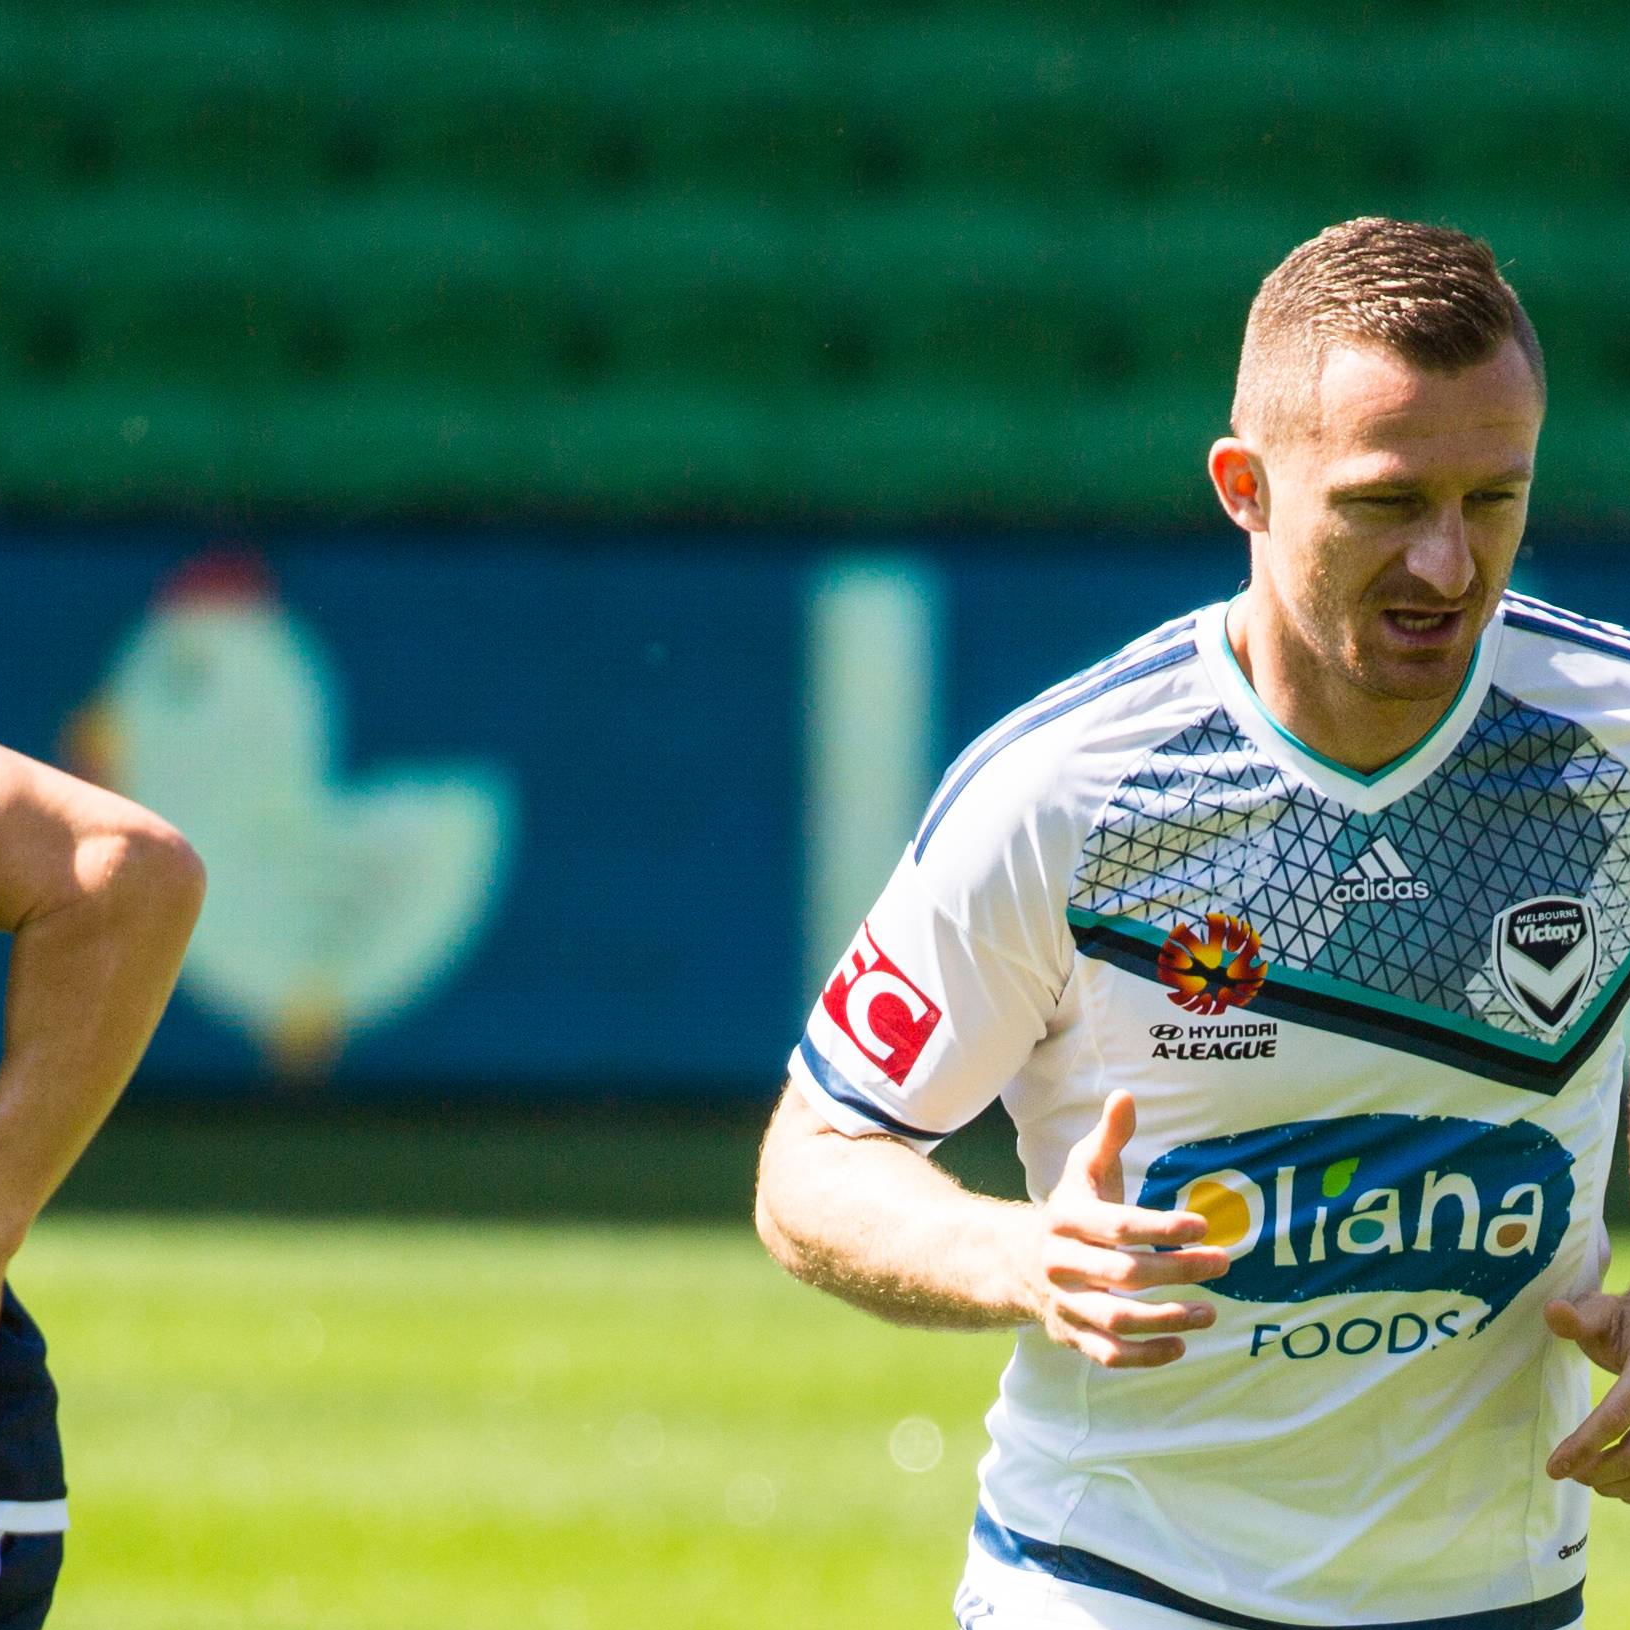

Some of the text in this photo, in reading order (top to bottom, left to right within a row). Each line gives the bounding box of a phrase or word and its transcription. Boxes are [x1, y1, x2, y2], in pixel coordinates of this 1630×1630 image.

[1332, 876, 1430, 903] adidas
[1515, 908, 1579, 925] MELBOURNE
[1513, 922, 1583, 946] Victory
[1188, 1022, 1278, 1039] HYUNDAI
[1151, 1039, 1278, 1061] A-LEAGUE
[1175, 1157, 1544, 1268] Oliana
[1249, 1309, 1461, 1360] FOODS
